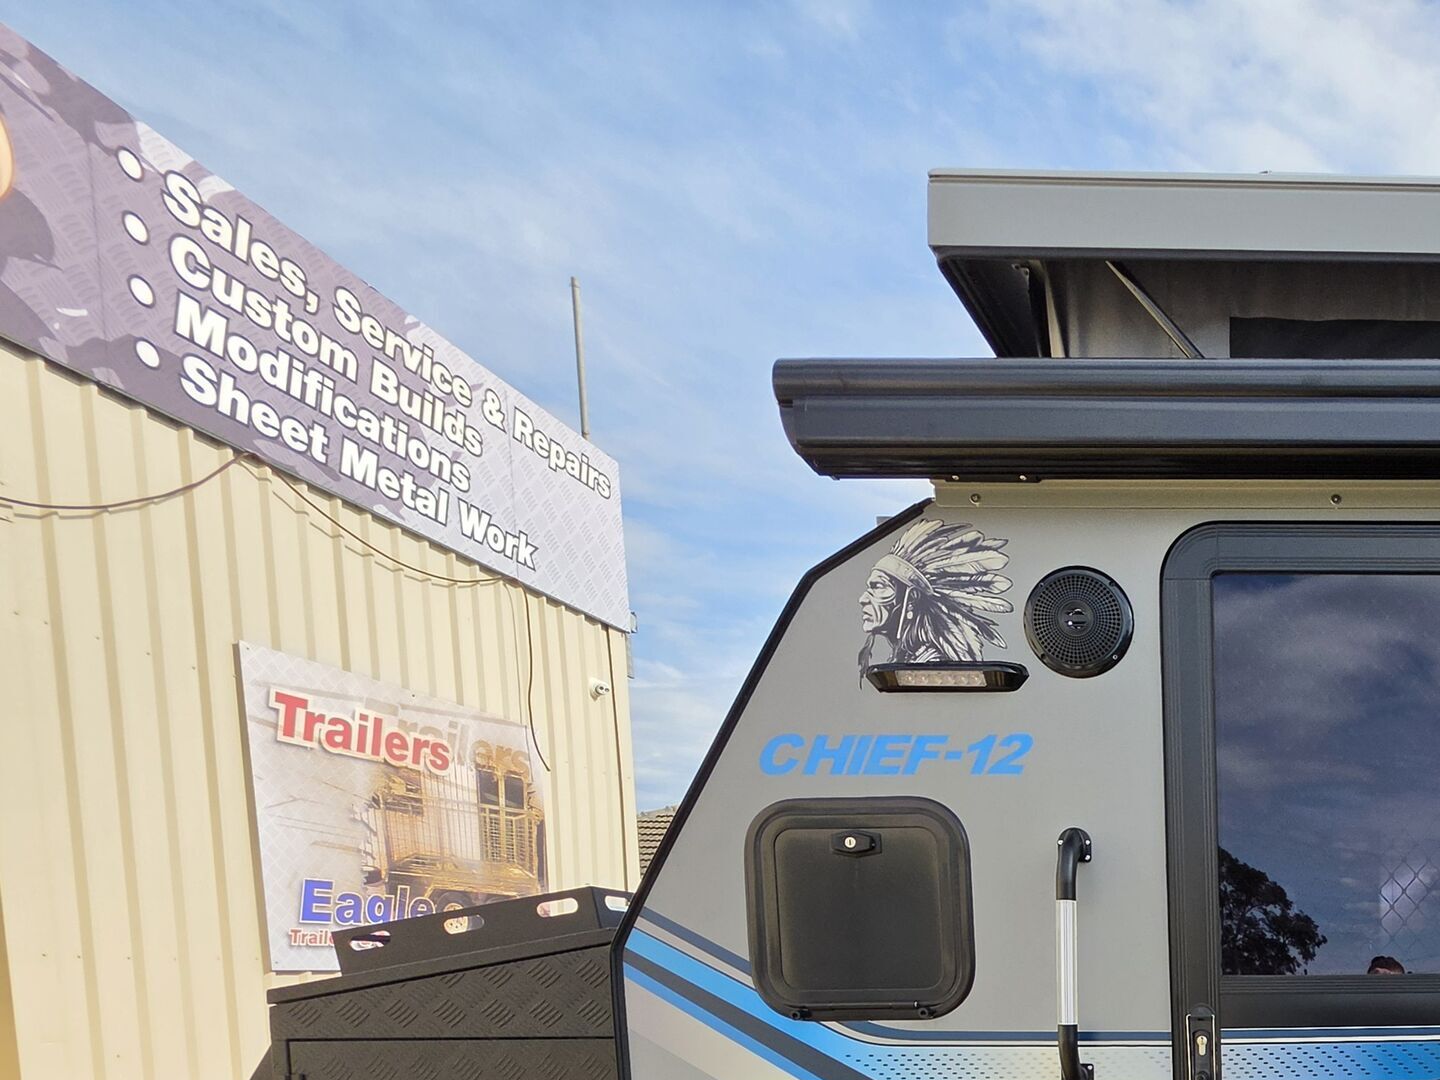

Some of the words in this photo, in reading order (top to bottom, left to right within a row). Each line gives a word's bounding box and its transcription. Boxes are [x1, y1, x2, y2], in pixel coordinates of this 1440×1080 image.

[162, 170, 320, 313] Sales,
[333, 286, 472, 407] Service
[481, 389, 505, 431] &
[513, 407, 612, 500] Repairs
[168, 234, 358, 382] Custom
[371, 364, 483, 456] Builds
[174, 292, 470, 492] Modifications
[180, 353, 330, 464] Sheet
[340, 439, 448, 527] Metal
[458, 499, 539, 571] Work
[269, 687, 451, 776] Trailers
[759, 732, 1034, 776] CHIEF-12
